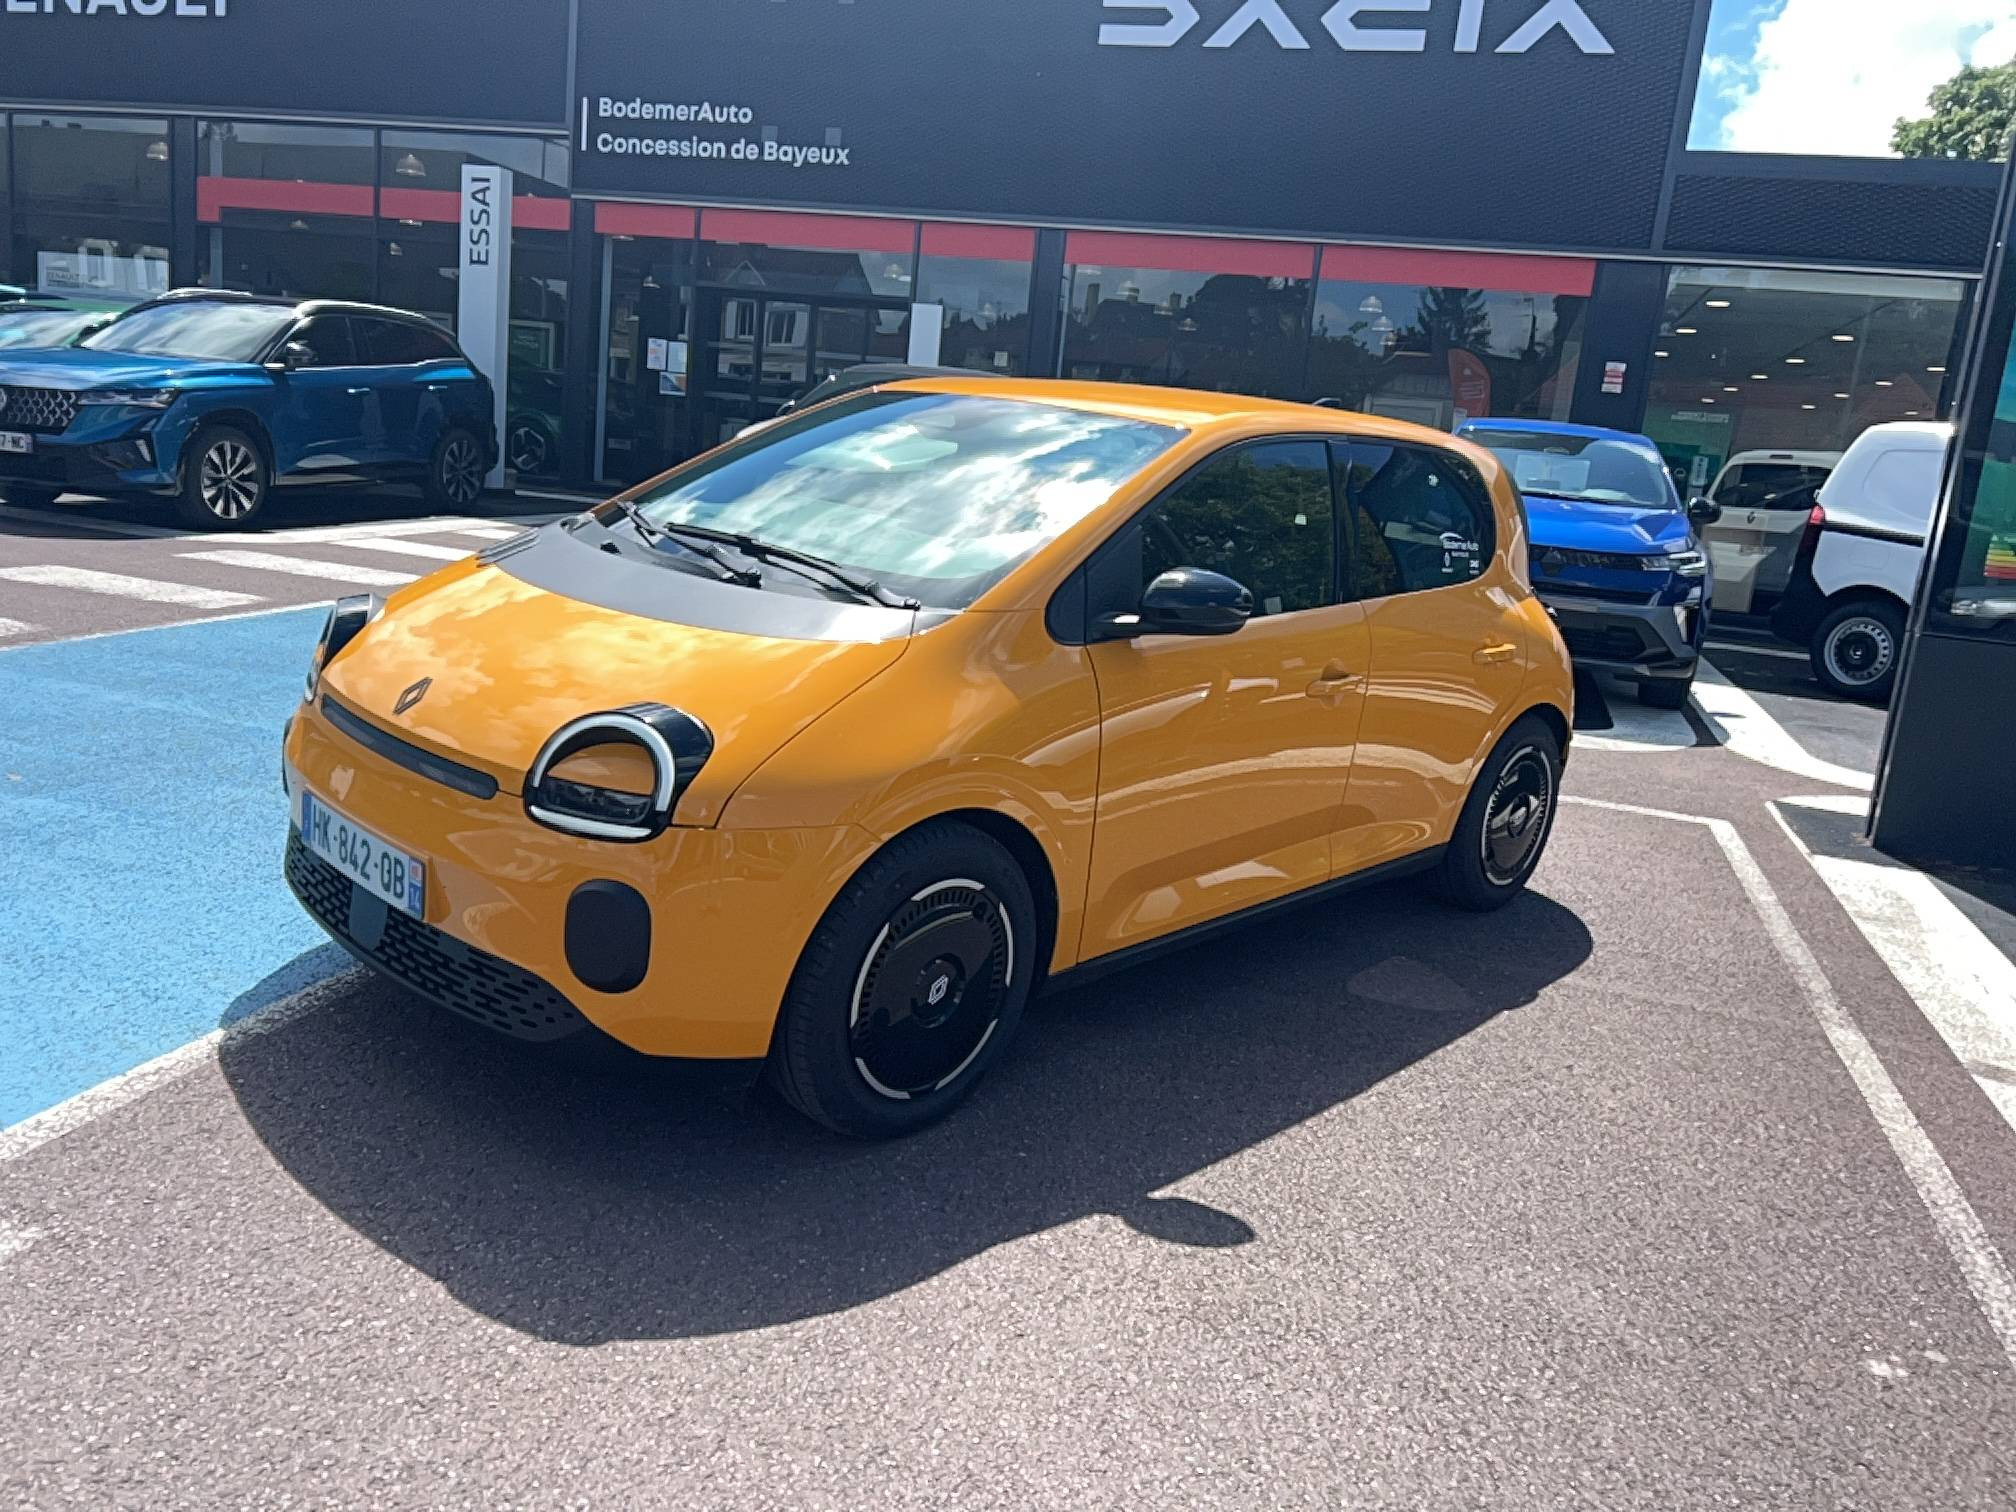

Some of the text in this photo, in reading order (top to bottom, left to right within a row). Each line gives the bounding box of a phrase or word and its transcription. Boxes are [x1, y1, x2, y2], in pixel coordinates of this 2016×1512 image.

[1097, 0, 1616, 55] DACIA
[598, 97, 753, 124] BodemerAuto
[596, 132, 850, 167] Concession de Bayeux
[469, 176, 491, 266] ESSAI
